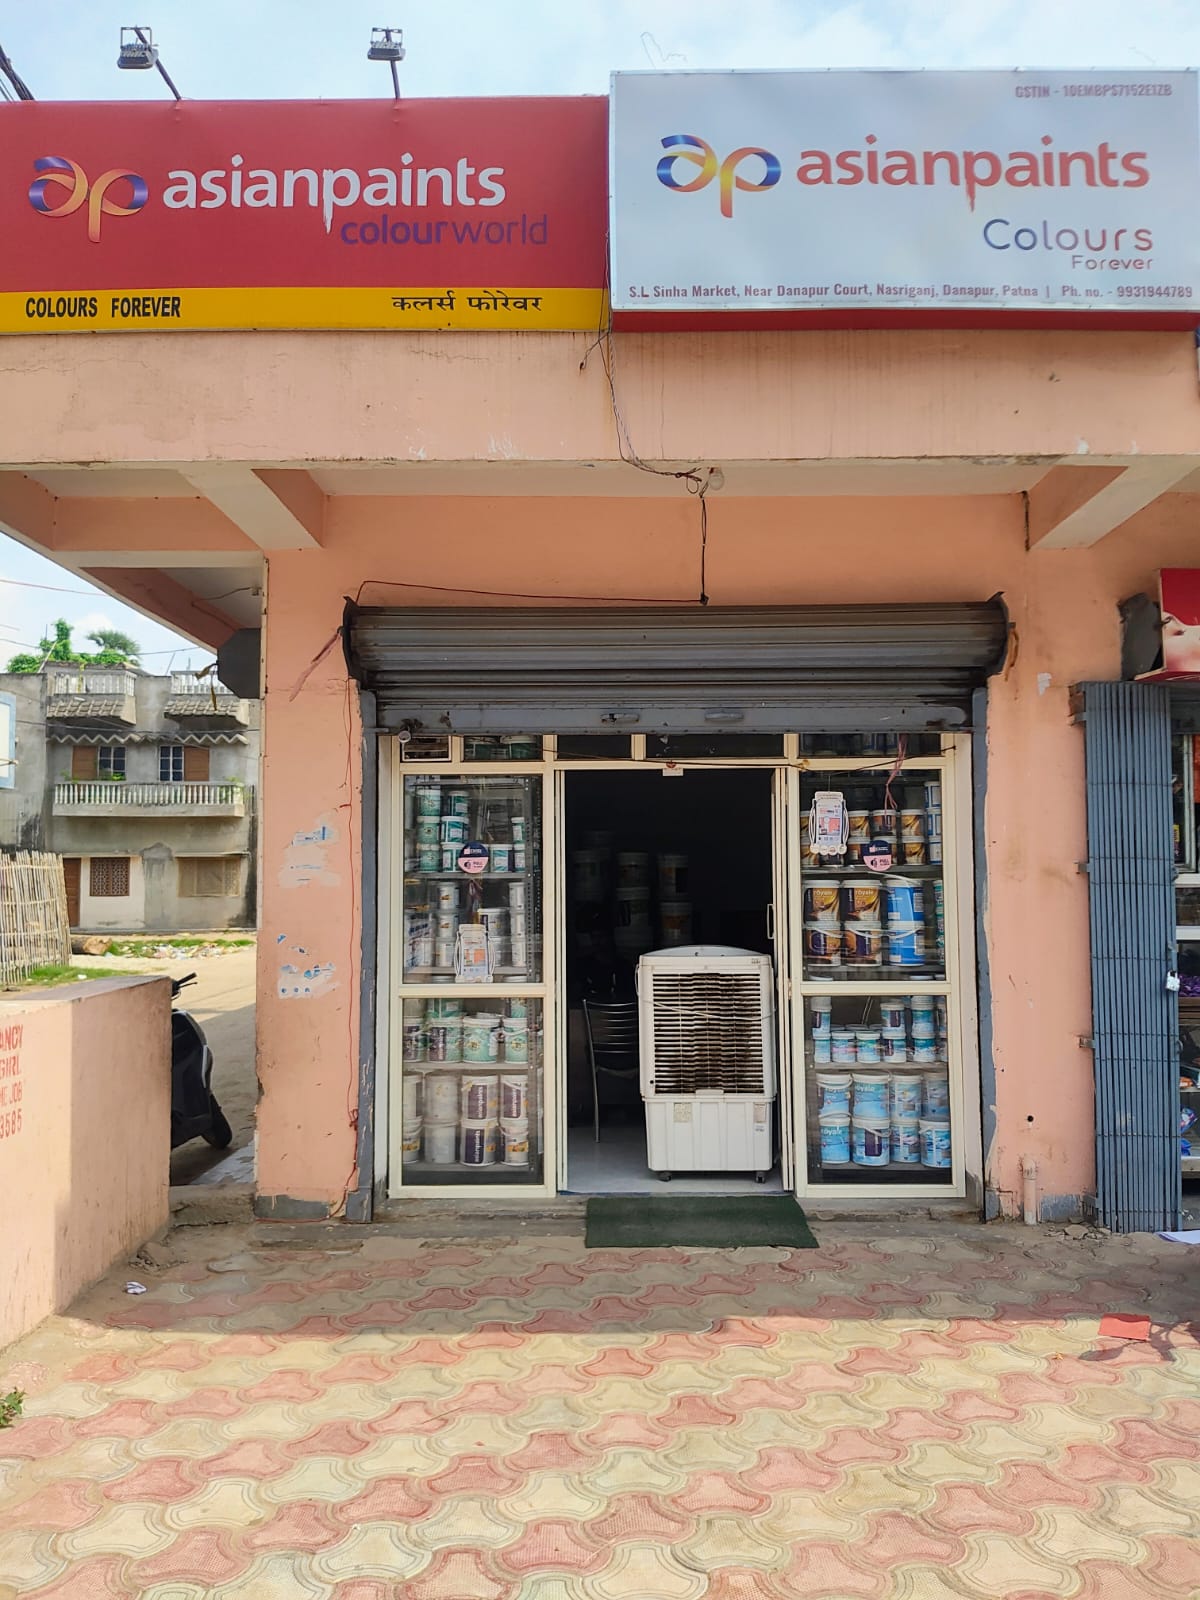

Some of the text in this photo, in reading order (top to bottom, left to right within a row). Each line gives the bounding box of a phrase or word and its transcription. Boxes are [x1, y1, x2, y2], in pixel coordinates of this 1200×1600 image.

[1015, 86, 1050, 98] GSTIN
[796, 134, 1150, 212] asianpaints
[163, 154, 506, 234] asianpaints
[341, 214, 548, 245] colourworld
[983, 218, 1153, 251] Colours
[1072, 255, 1153, 270] Forever
[392, 290, 543, 311] कलर्स फोरेवर
[653, 286, 688, 298] Sinha
[692, 285, 740, 299] Market,
[744, 285, 773, 297] Near
[777, 285, 830, 299] Danapur
[834, 283, 873, 297] Court,
[876, 284, 939, 298] Nasriganj,
[943, 284, 999, 298] Danapur,
[1003, 285, 1038, 297] Patna
[1062, 285, 1082, 297] Ph.
[1085, 287, 1104, 297] no.
[1117, 286, 1193, 298] 9931944789
[26, 296, 181, 318] COLOURS FOREVER
